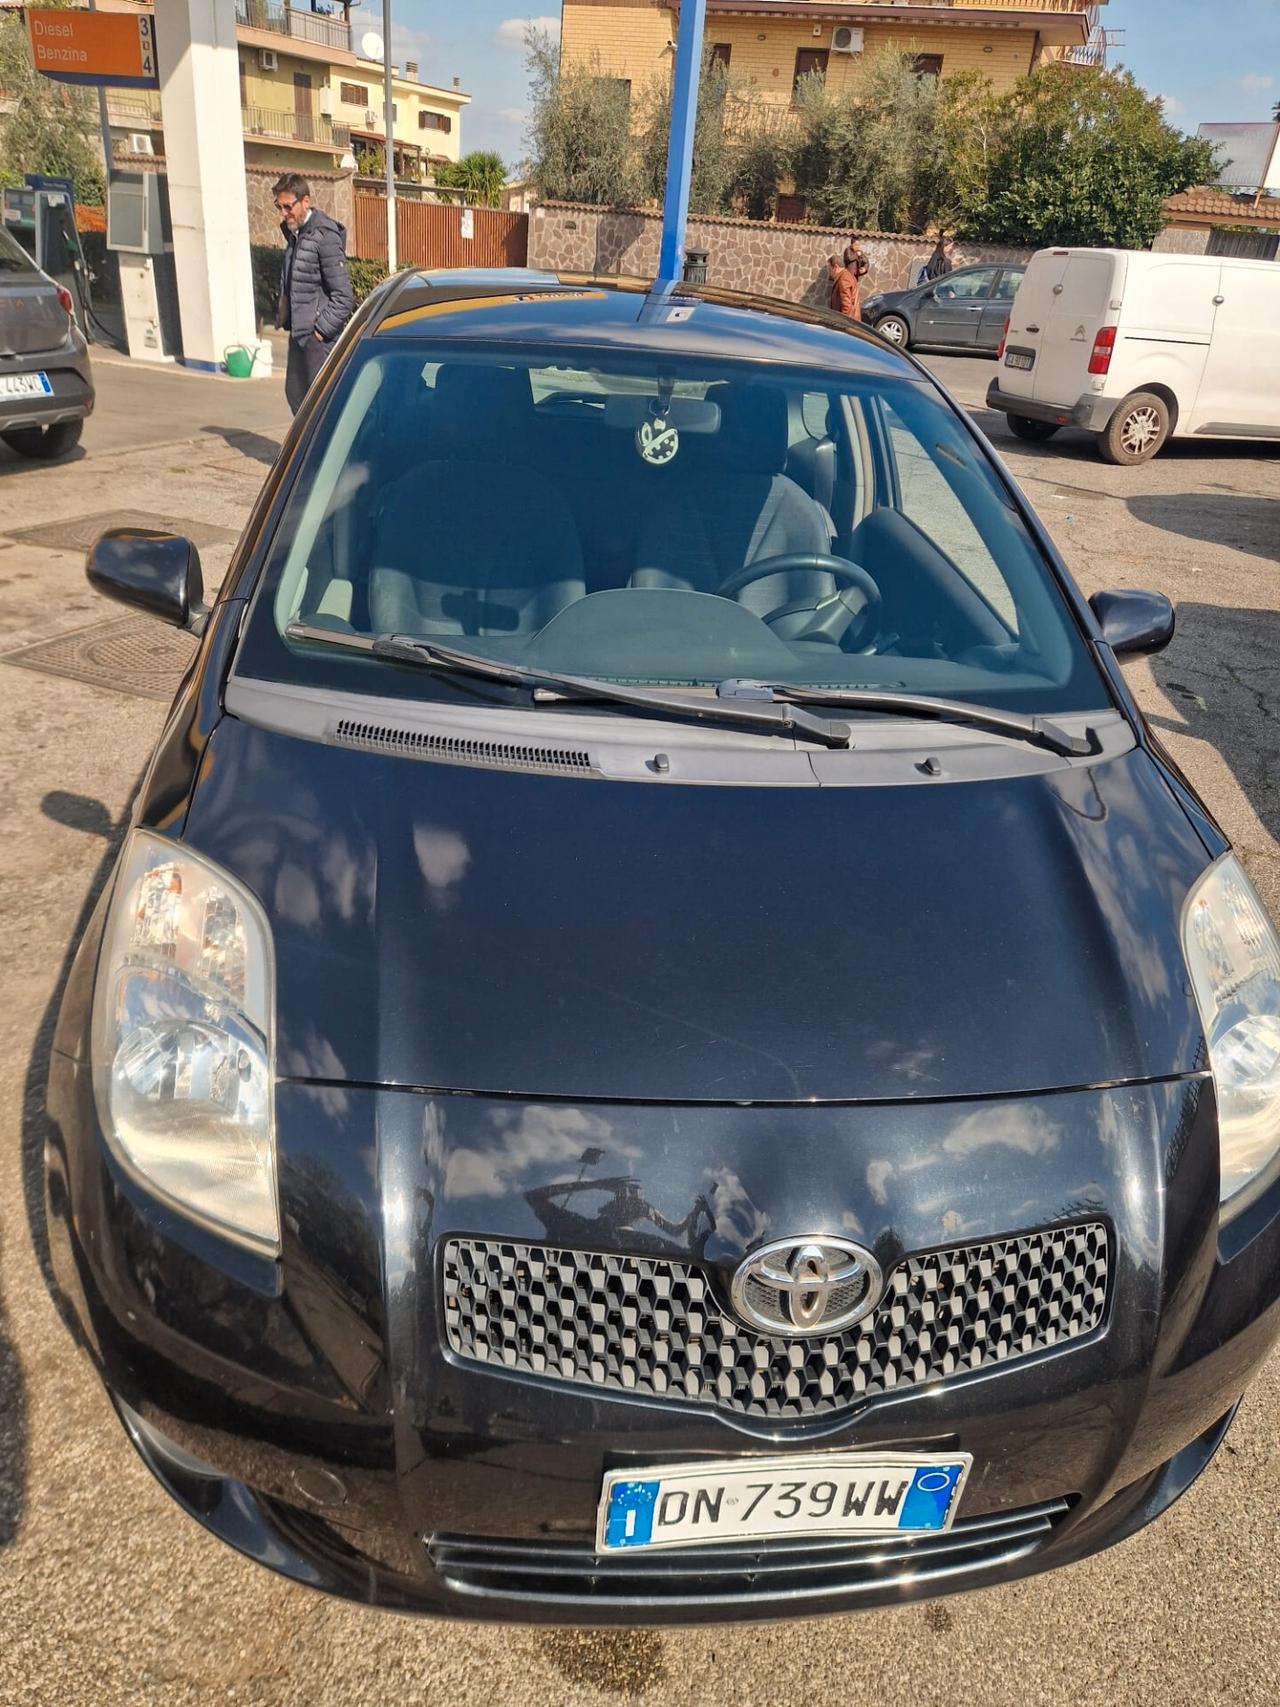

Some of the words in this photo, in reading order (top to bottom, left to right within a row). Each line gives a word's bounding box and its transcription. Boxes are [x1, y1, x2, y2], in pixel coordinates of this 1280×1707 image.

[34, 20, 74, 37] Diesel
[140, 17, 149, 37] 3
[37, 44, 88, 62] Benzina
[143, 56, 152, 73] 4
[657, 1486, 726, 1527] DN
[740, 1479, 910, 1522] 739WW
